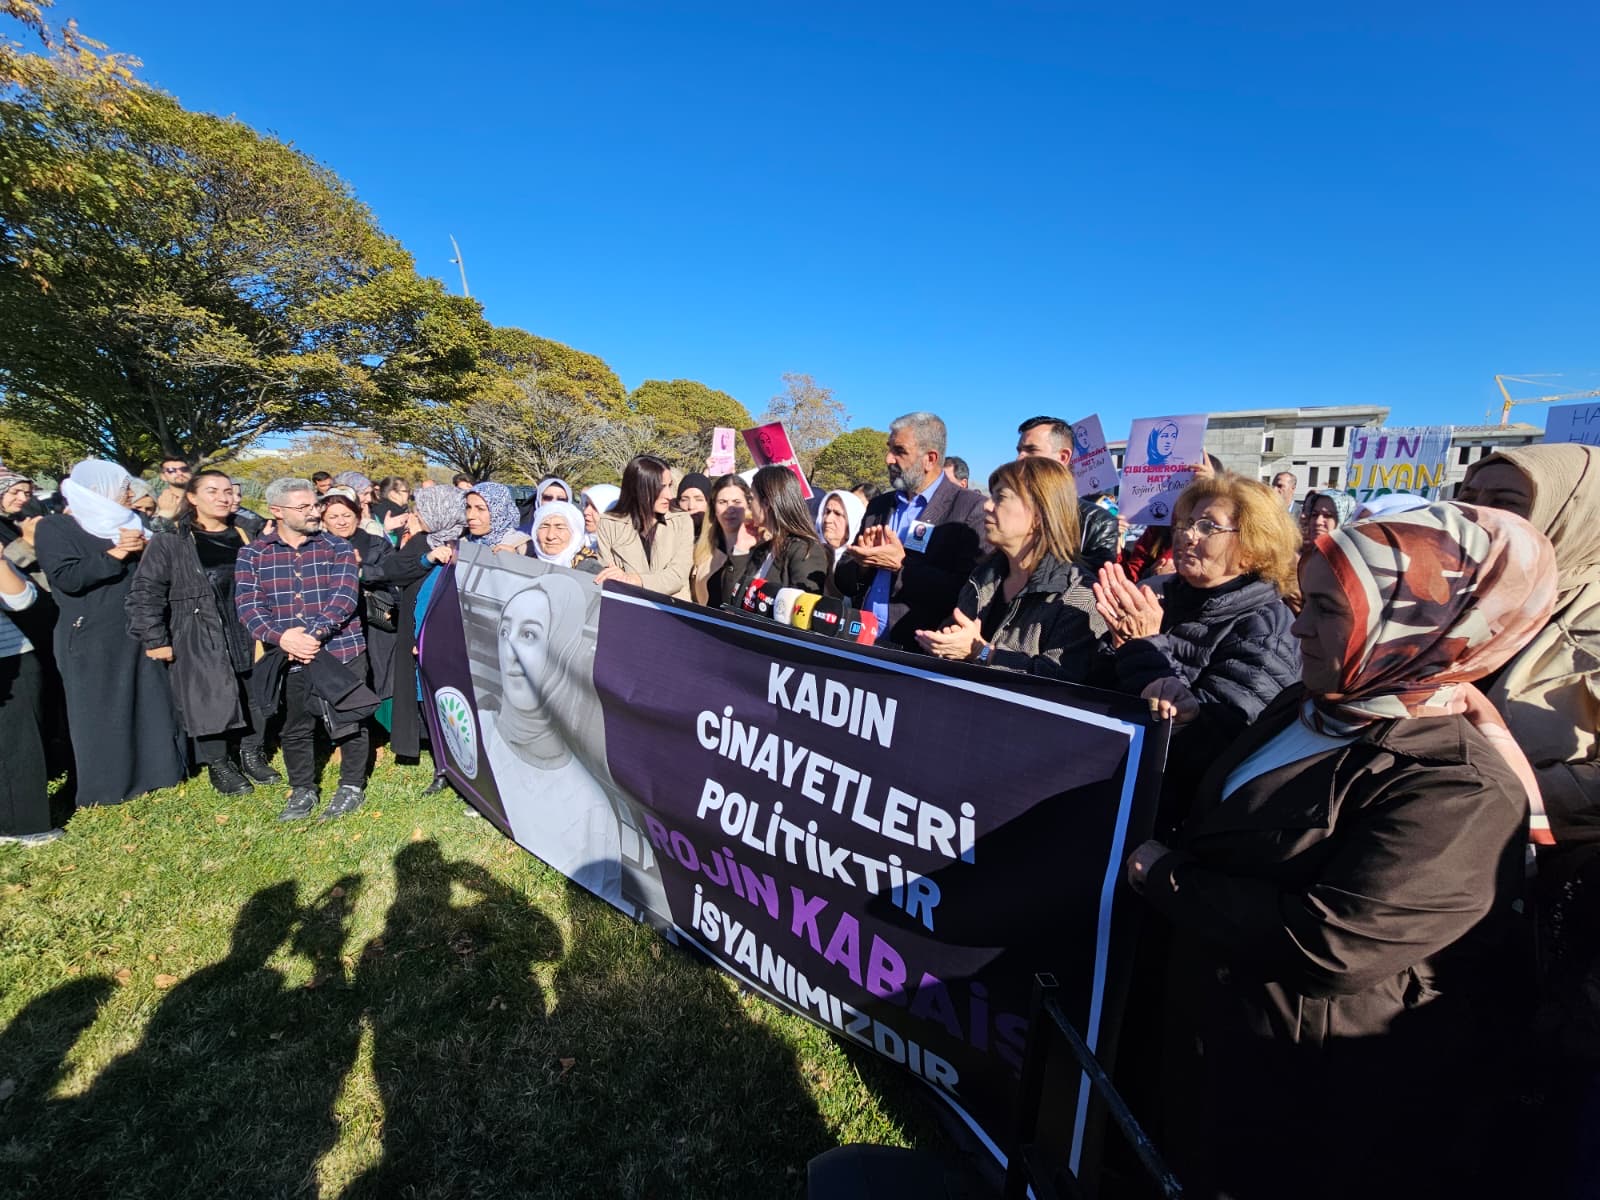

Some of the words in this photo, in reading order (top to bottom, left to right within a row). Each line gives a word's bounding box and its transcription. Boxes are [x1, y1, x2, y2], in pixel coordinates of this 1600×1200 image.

[1348, 463, 1443, 489] JIYAN
[1354, 436, 1421, 459] JIN
[768, 662, 897, 748] KADIN
[696, 705, 976, 864] CİNAYETLERİ
[643, 812, 779, 919] ROJİN
[696, 778, 941, 931] POLİTİKTİR
[692, 884, 958, 1096] İSYANIMIZDIR
